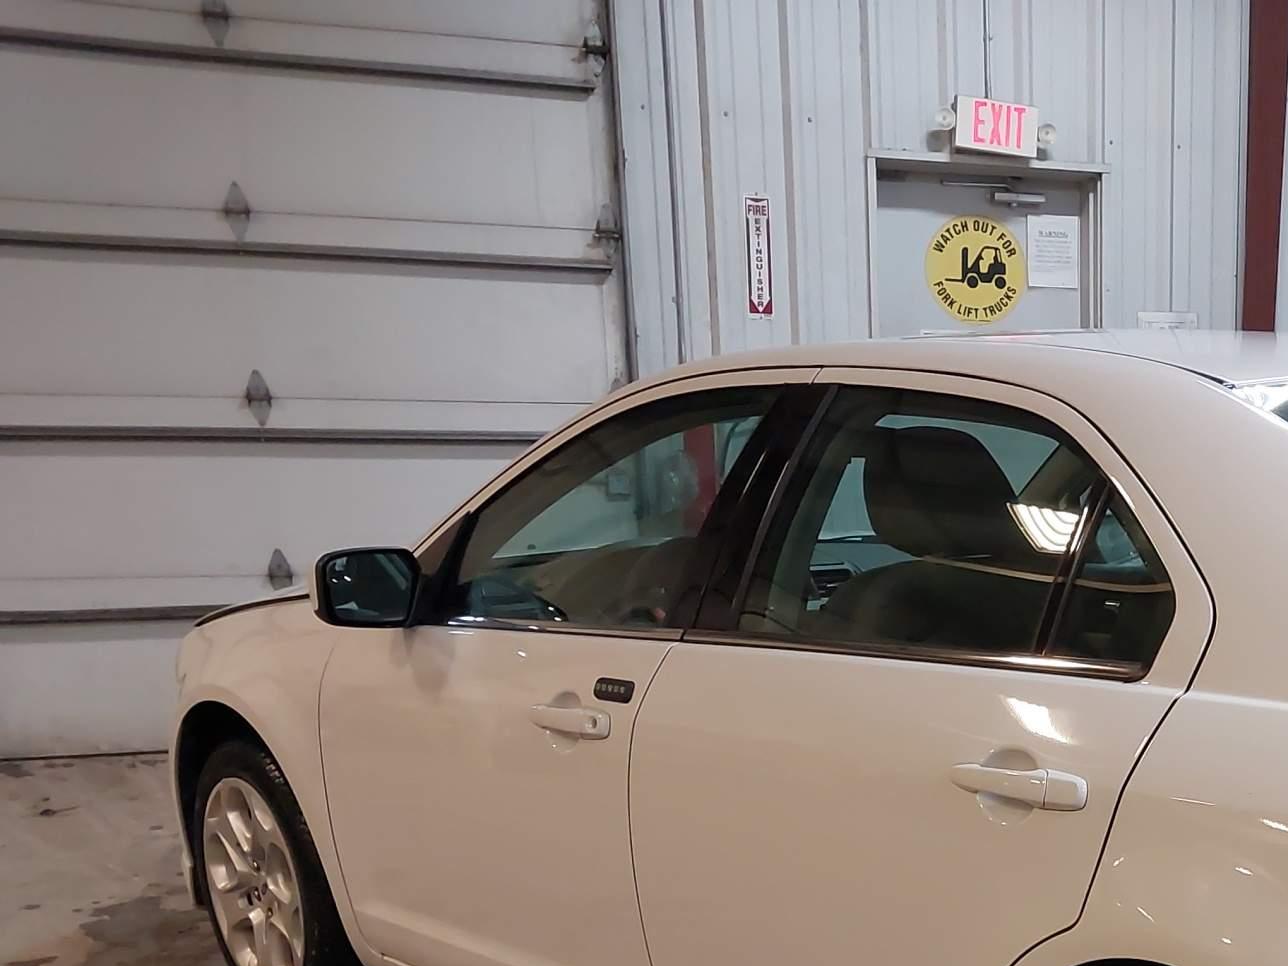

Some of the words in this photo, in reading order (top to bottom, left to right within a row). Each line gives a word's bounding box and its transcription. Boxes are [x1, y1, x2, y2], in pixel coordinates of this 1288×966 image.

[973, 100, 1026, 150] EXIT
[747, 204, 767, 216] FIRE
[932, 220, 970, 253] WATCH
[973, 219, 998, 236] OUT
[996, 232, 1018, 258] FOR
[754, 218, 764, 307] EXTINGUISHER
[933, 280, 957, 310] FORK
[957, 304, 980, 319] LIFT
[982, 285, 1017, 319] TRUCKS
